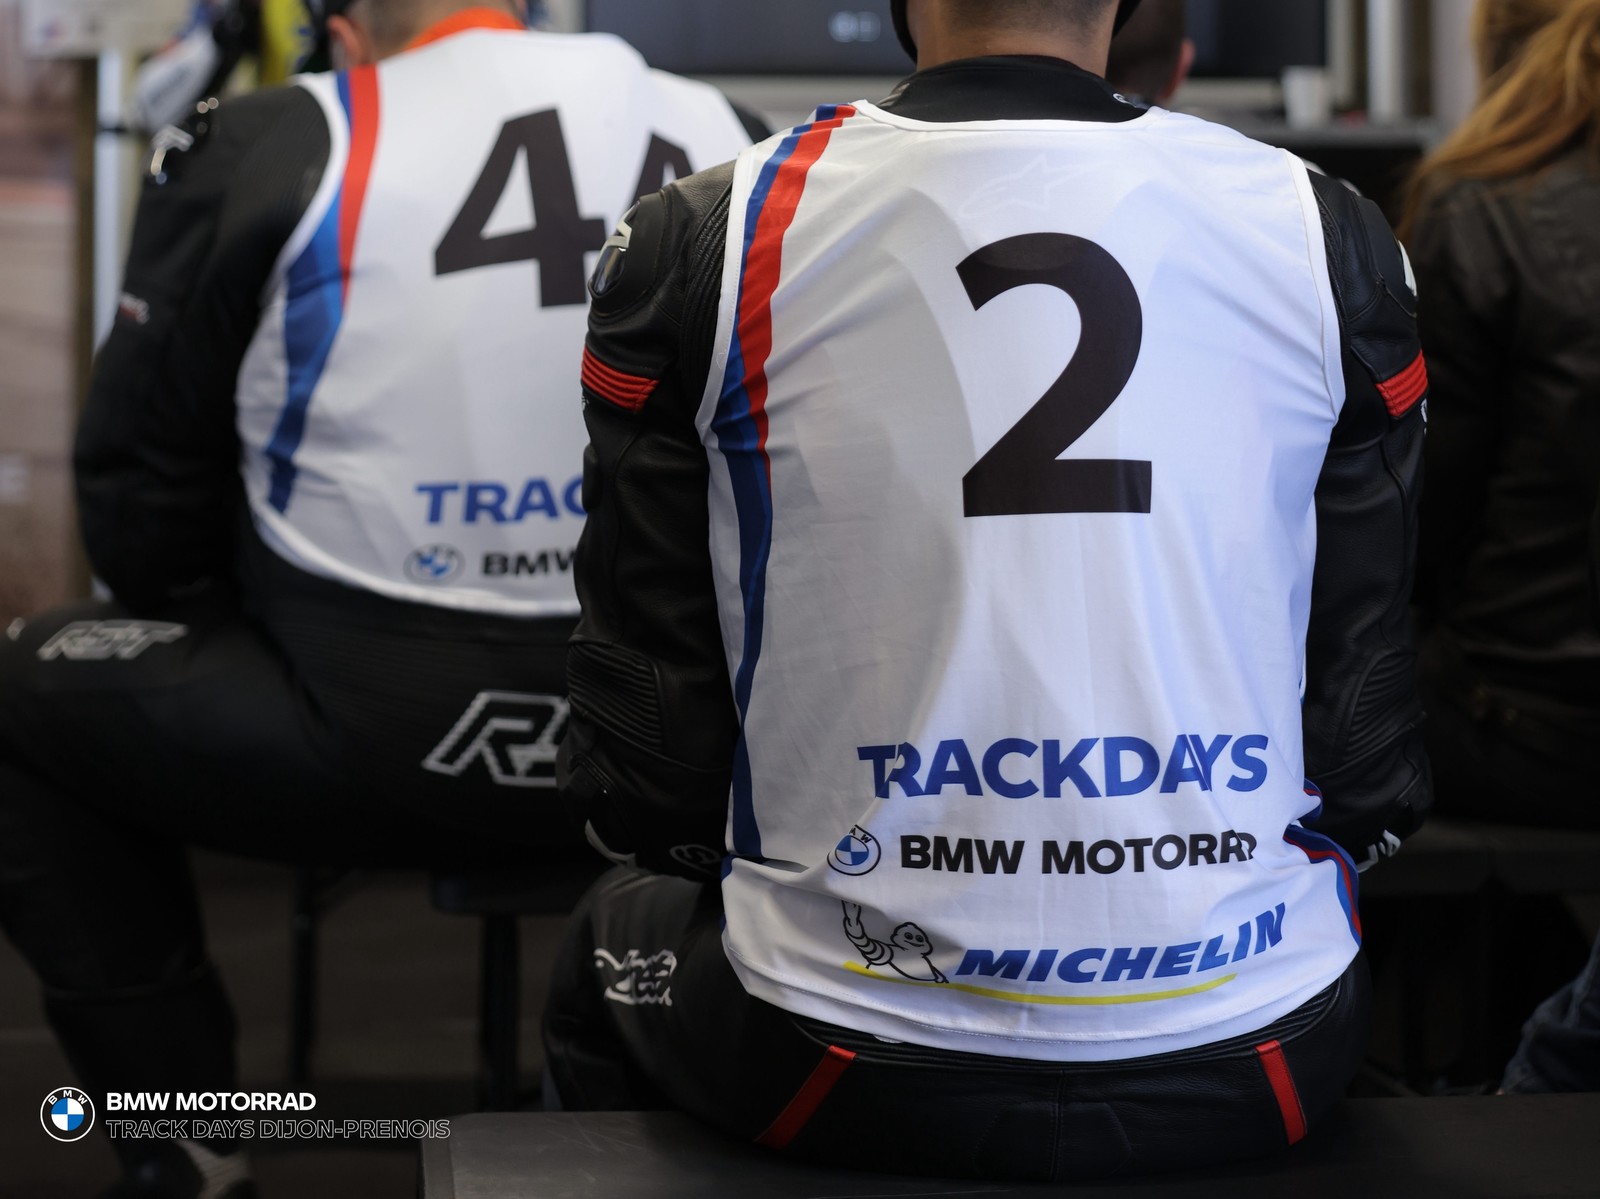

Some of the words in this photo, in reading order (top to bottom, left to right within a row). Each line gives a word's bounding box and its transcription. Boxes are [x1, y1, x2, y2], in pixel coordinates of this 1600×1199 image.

[955, 232, 1152, 517] 2
[857, 733, 1269, 798] TRACKDAYS
[900, 834, 1025, 874] BMW
[955, 902, 1286, 983] MICHELIN
